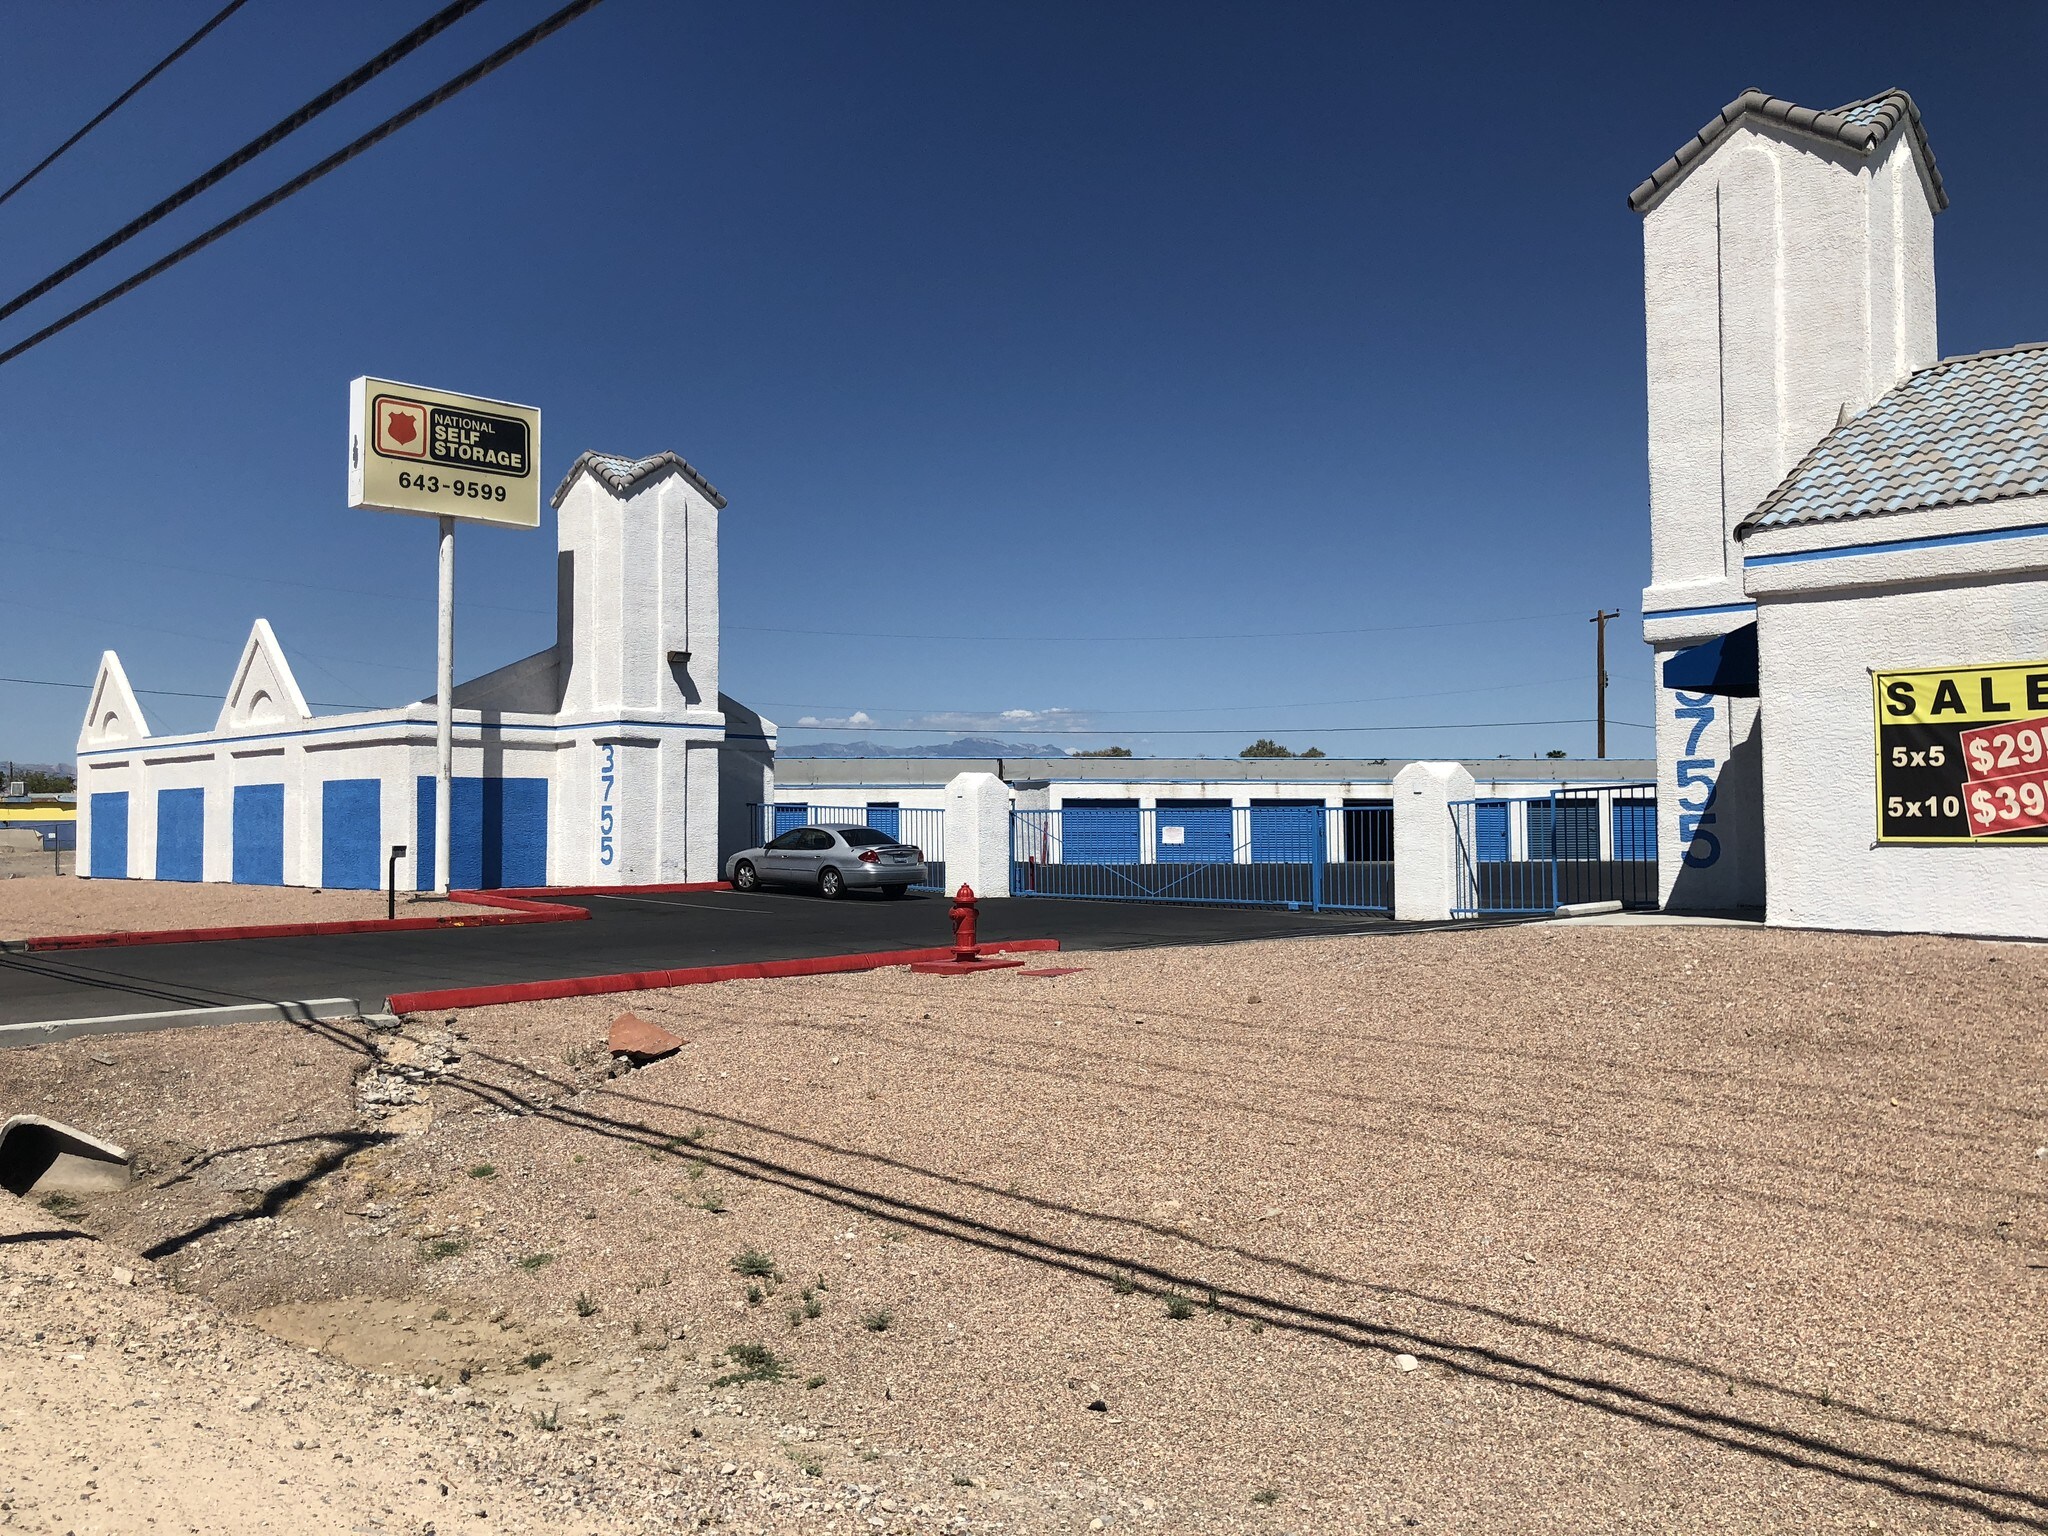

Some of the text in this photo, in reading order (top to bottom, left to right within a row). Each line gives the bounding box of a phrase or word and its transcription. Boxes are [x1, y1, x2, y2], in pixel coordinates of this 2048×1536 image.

[434, 413, 496, 434] NATIONAL
[434, 425, 480, 445] SELF
[434, 441, 522, 468] STORAGE
[399, 471, 507, 502] 643-9599
[1886, 673, 2048, 716] SALE
[1892, 746, 1946, 768] 5x5
[600, 743, 615, 866] 3755
[1887, 795, 1960, 818] 5x10
[1970, 779, 2048, 827] $39
